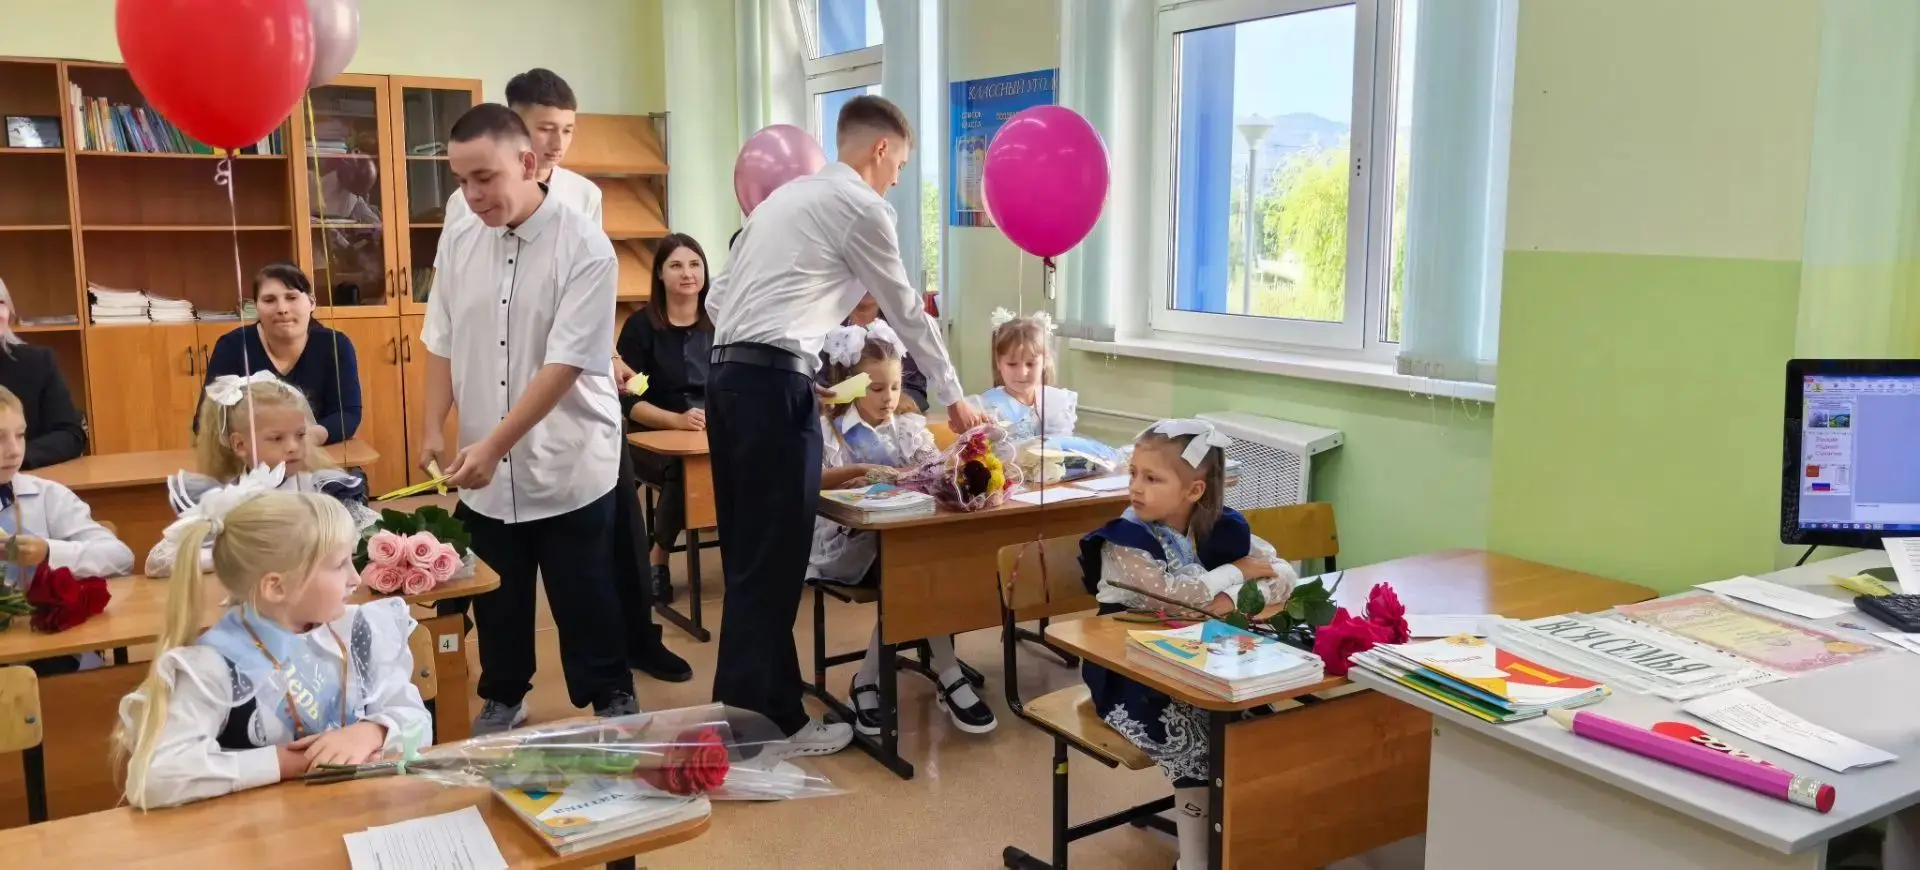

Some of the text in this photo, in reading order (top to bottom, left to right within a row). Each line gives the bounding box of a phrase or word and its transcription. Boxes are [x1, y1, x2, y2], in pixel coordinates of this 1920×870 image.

[443, 639, 450, 649] 4
[1532, 620, 1713, 675] ВСЯ СЕМЬЯ
